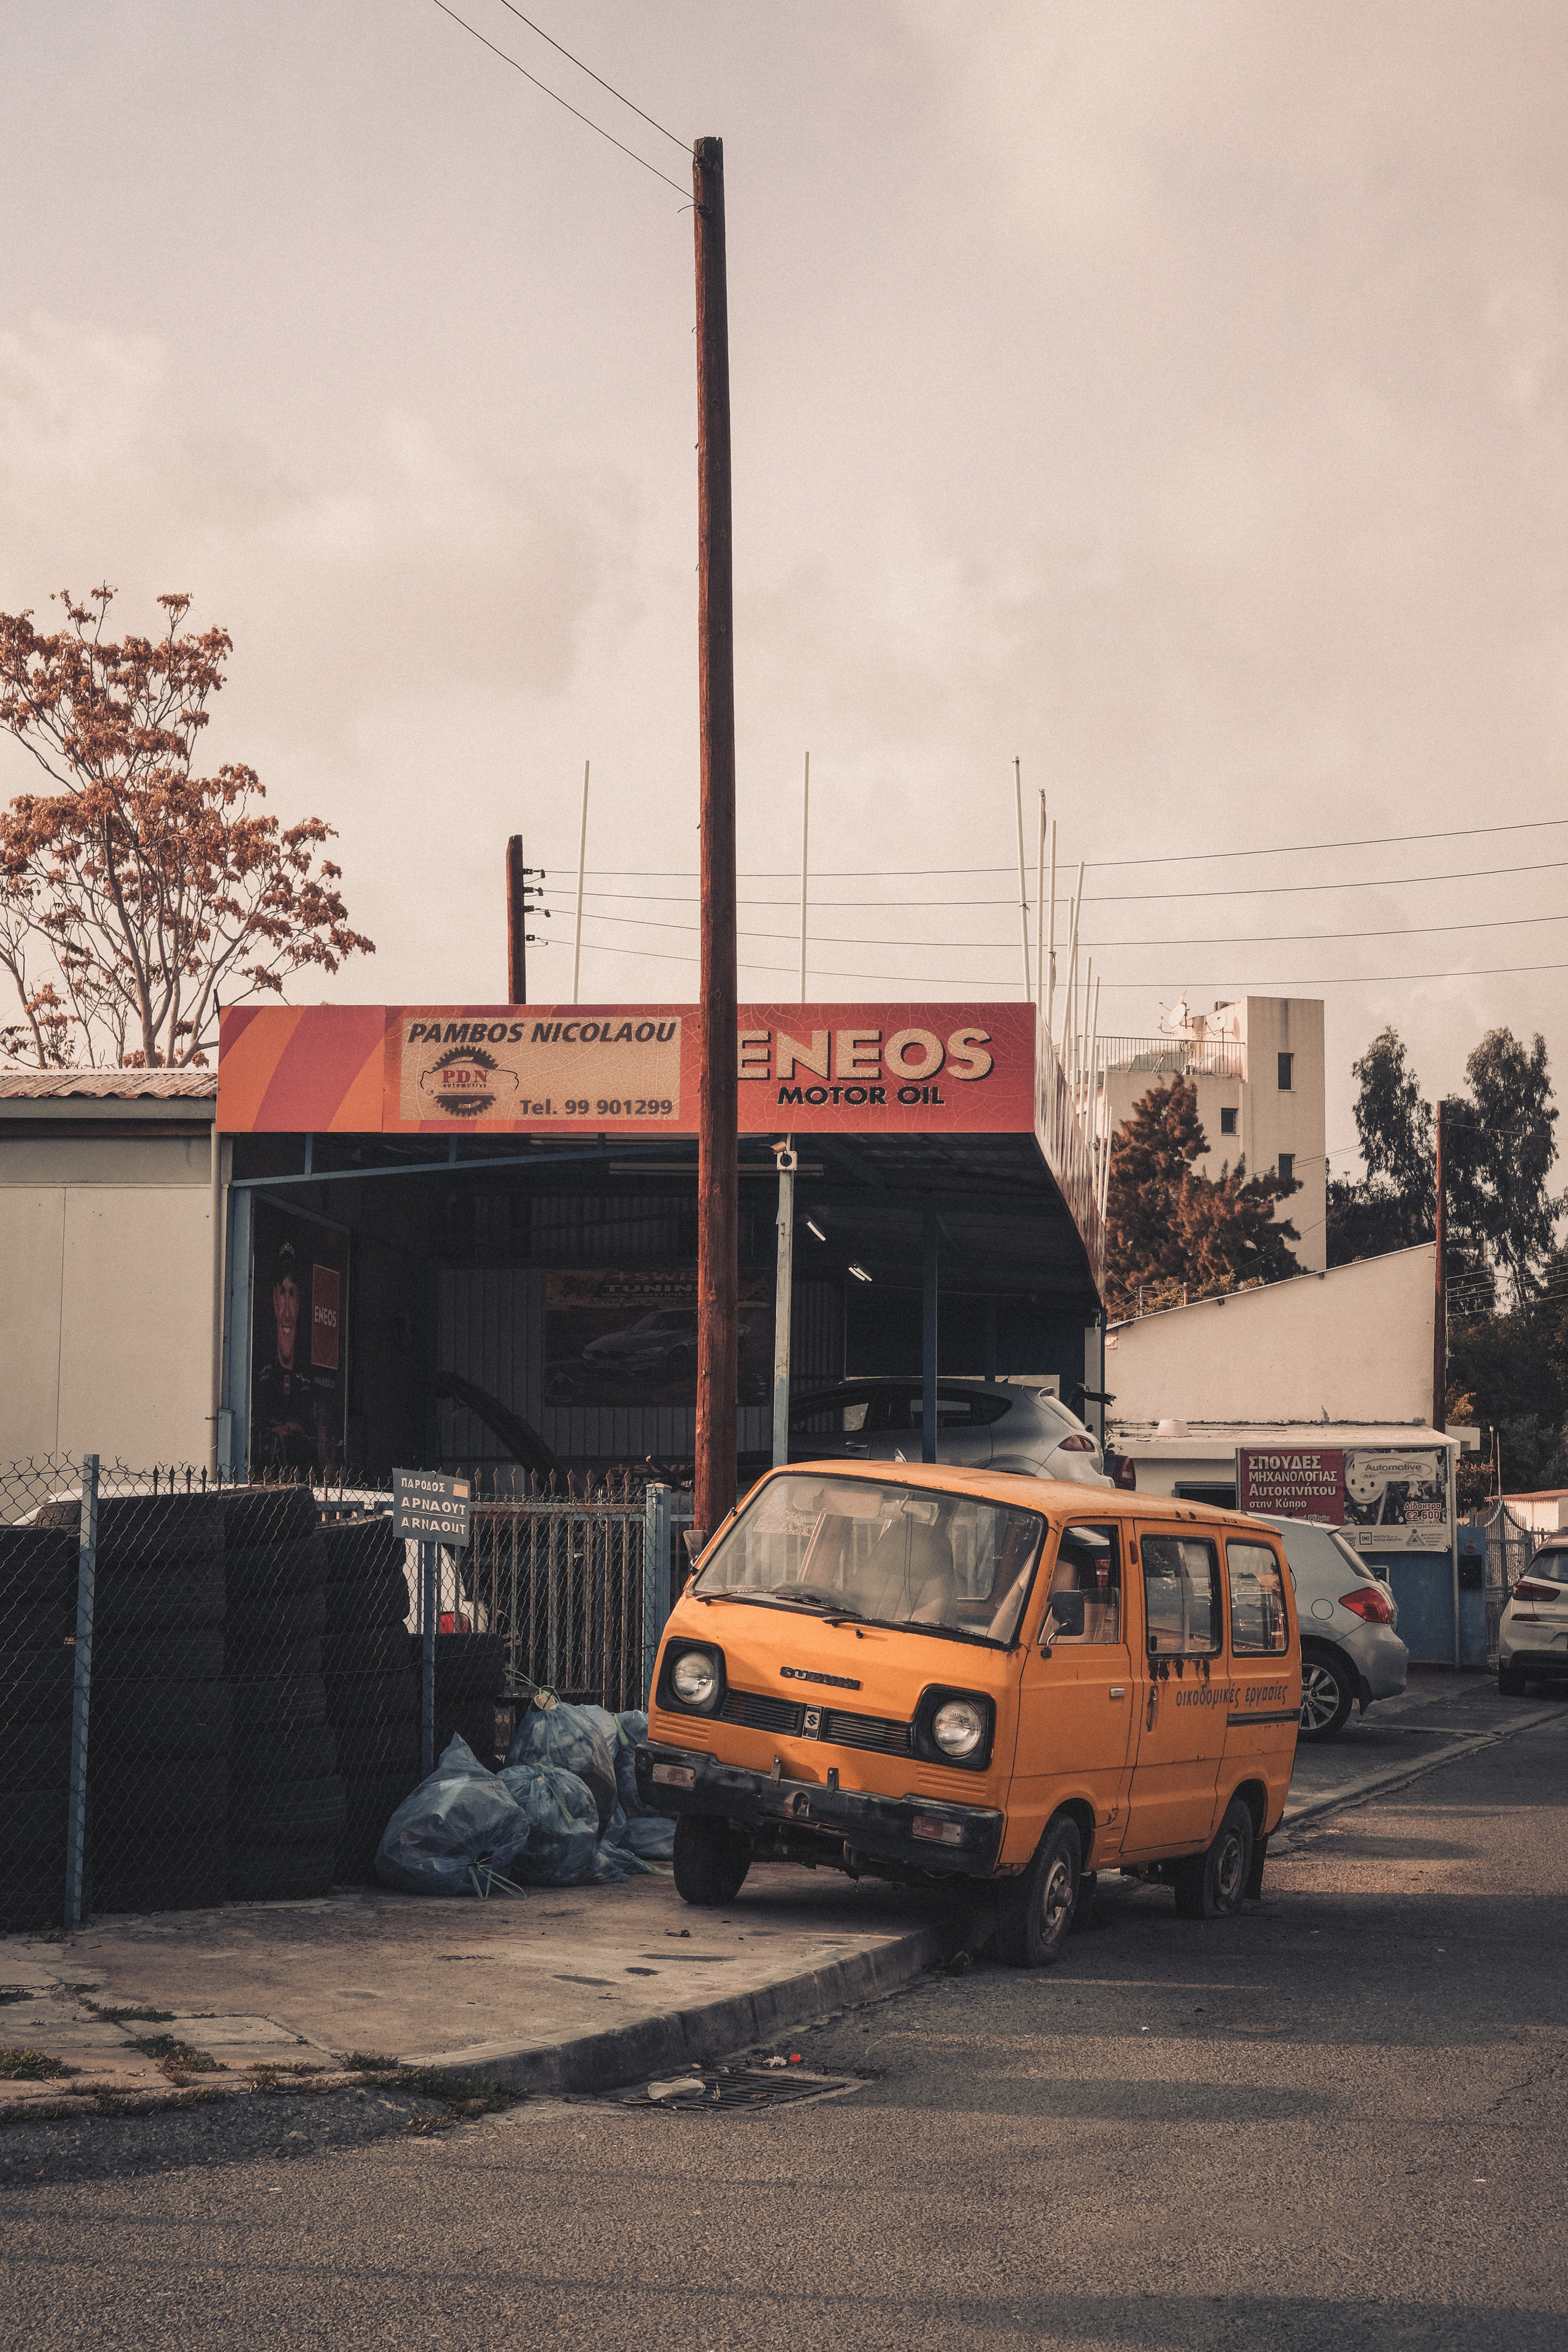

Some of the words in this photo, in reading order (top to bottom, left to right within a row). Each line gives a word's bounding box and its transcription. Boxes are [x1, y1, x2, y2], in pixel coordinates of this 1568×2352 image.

[408, 1023, 525, 1042] PAMBOS
[531, 1022, 676, 1042] NICOLAOU
[737, 1028, 994, 1082] ENEOS
[442, 1070, 489, 1083] PDN
[777, 1086, 886, 1106] MOTOR
[897, 1086, 945, 1105] OIL
[520, 1099, 557, 1115] Tel.
[565, 1099, 589, 1115] 99
[597, 1099, 673, 1115] 901299
[314, 1305, 337, 1328] ENEOS
[1248, 1455, 1321, 1469] ΣΠΟΥΔΕΣ
[1249, 1471, 1338, 1482] ΜΗΧΑΝΟΛΟΓΙΑΣ
[401, 1477, 445, 1493] ΠΑΡΟΔΟΣ
[1249, 1482, 1336, 1496] Αυτοκινήτου
[401, 1496, 466, 1515] ΑΡΝΑΟΥΤ
[1276, 1498, 1307, 1510] Κύπρο
[1404, 1501, 1441, 1510] Δίδακτρα
[1406, 1511, 1440, 1521] €2,600
[401, 1517, 466, 1534] ARNAOUT
[780, 1666, 861, 1691] SUZUKI
[1176, 1683, 1242, 1709] οικοδομικές
[1245, 1681, 1288, 1707] εργασίες
